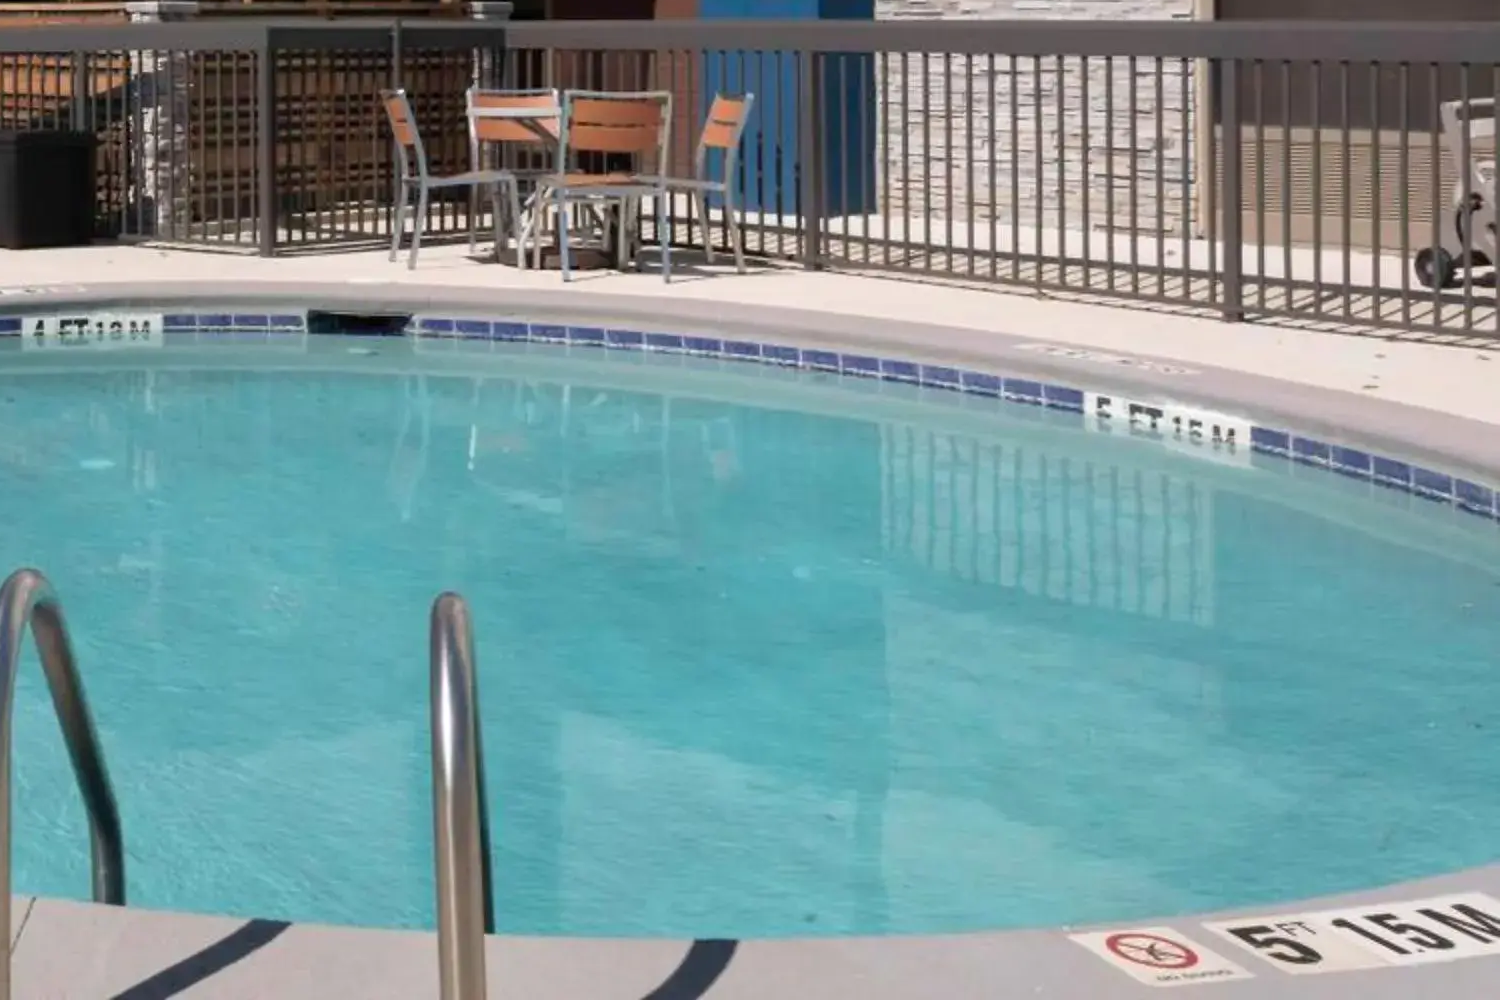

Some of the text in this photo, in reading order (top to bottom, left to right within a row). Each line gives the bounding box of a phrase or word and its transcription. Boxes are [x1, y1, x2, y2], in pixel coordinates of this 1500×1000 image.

[58, 318, 89, 336] FT
[1275, 920, 1317, 937] FT
[1227, 924, 1324, 966] 5
